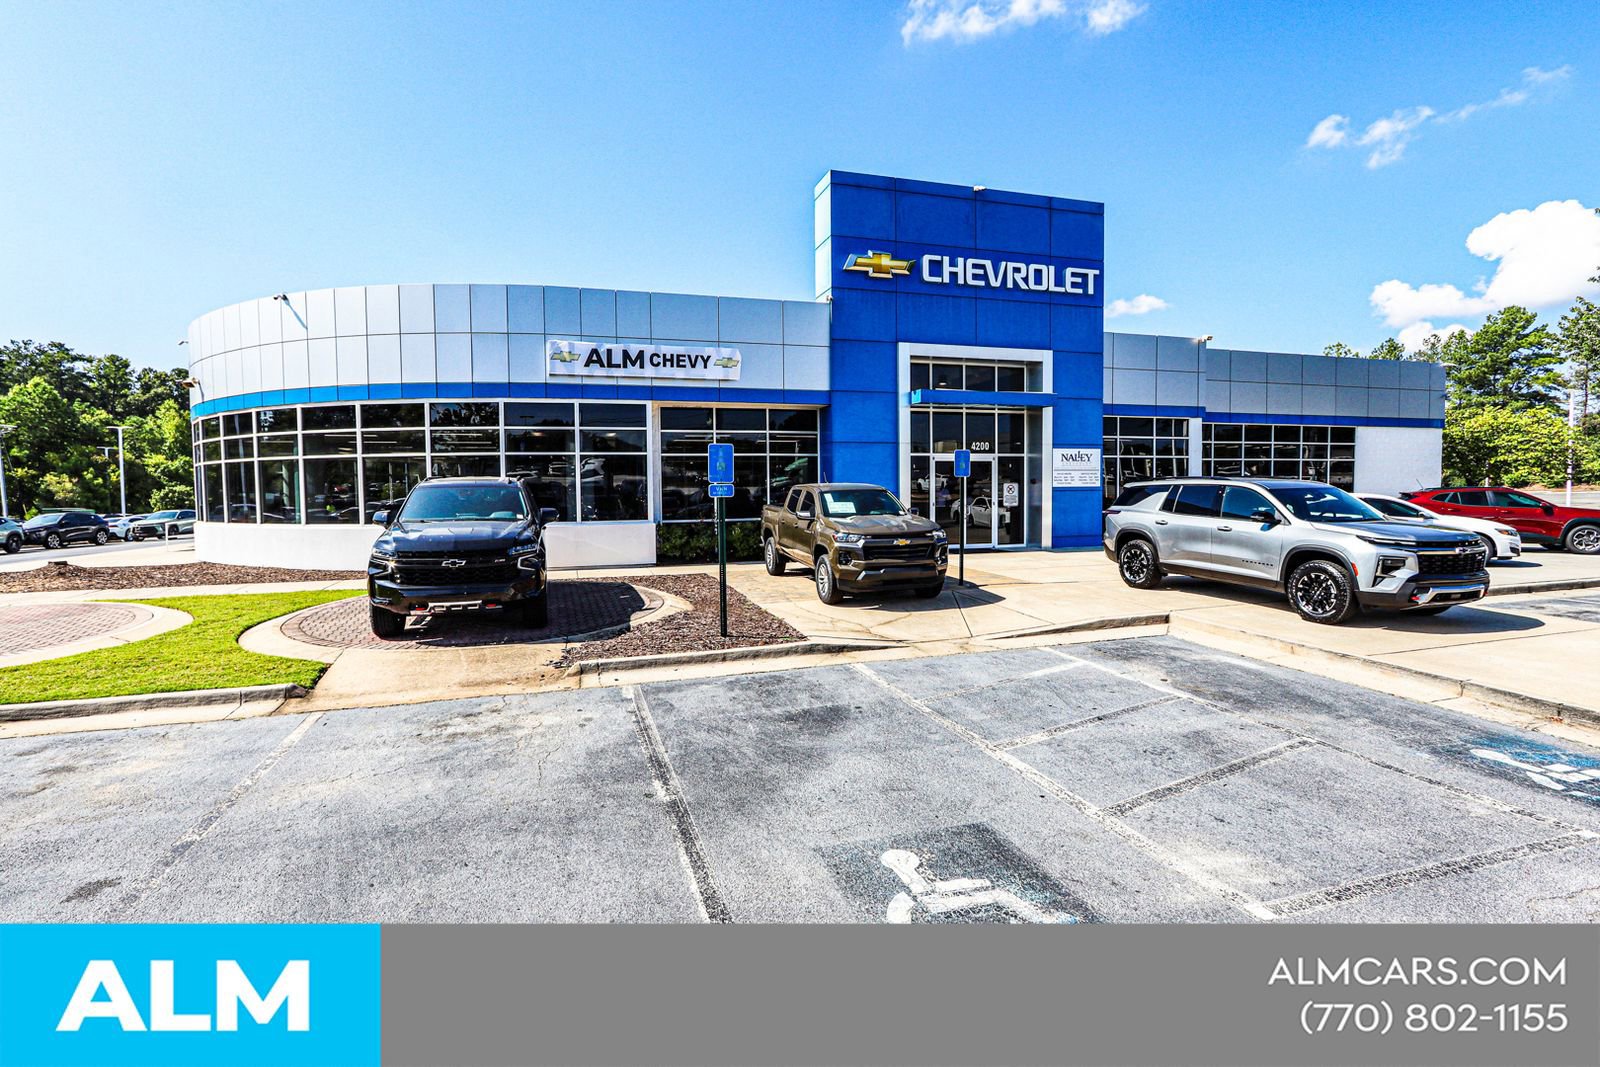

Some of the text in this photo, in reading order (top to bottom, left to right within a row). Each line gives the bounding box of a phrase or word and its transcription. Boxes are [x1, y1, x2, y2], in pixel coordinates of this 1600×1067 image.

[921, 254, 1100, 295] CHEVROLET
[584, 348, 711, 369] ALM CHEVY
[971, 441, 990, 451] 4200
